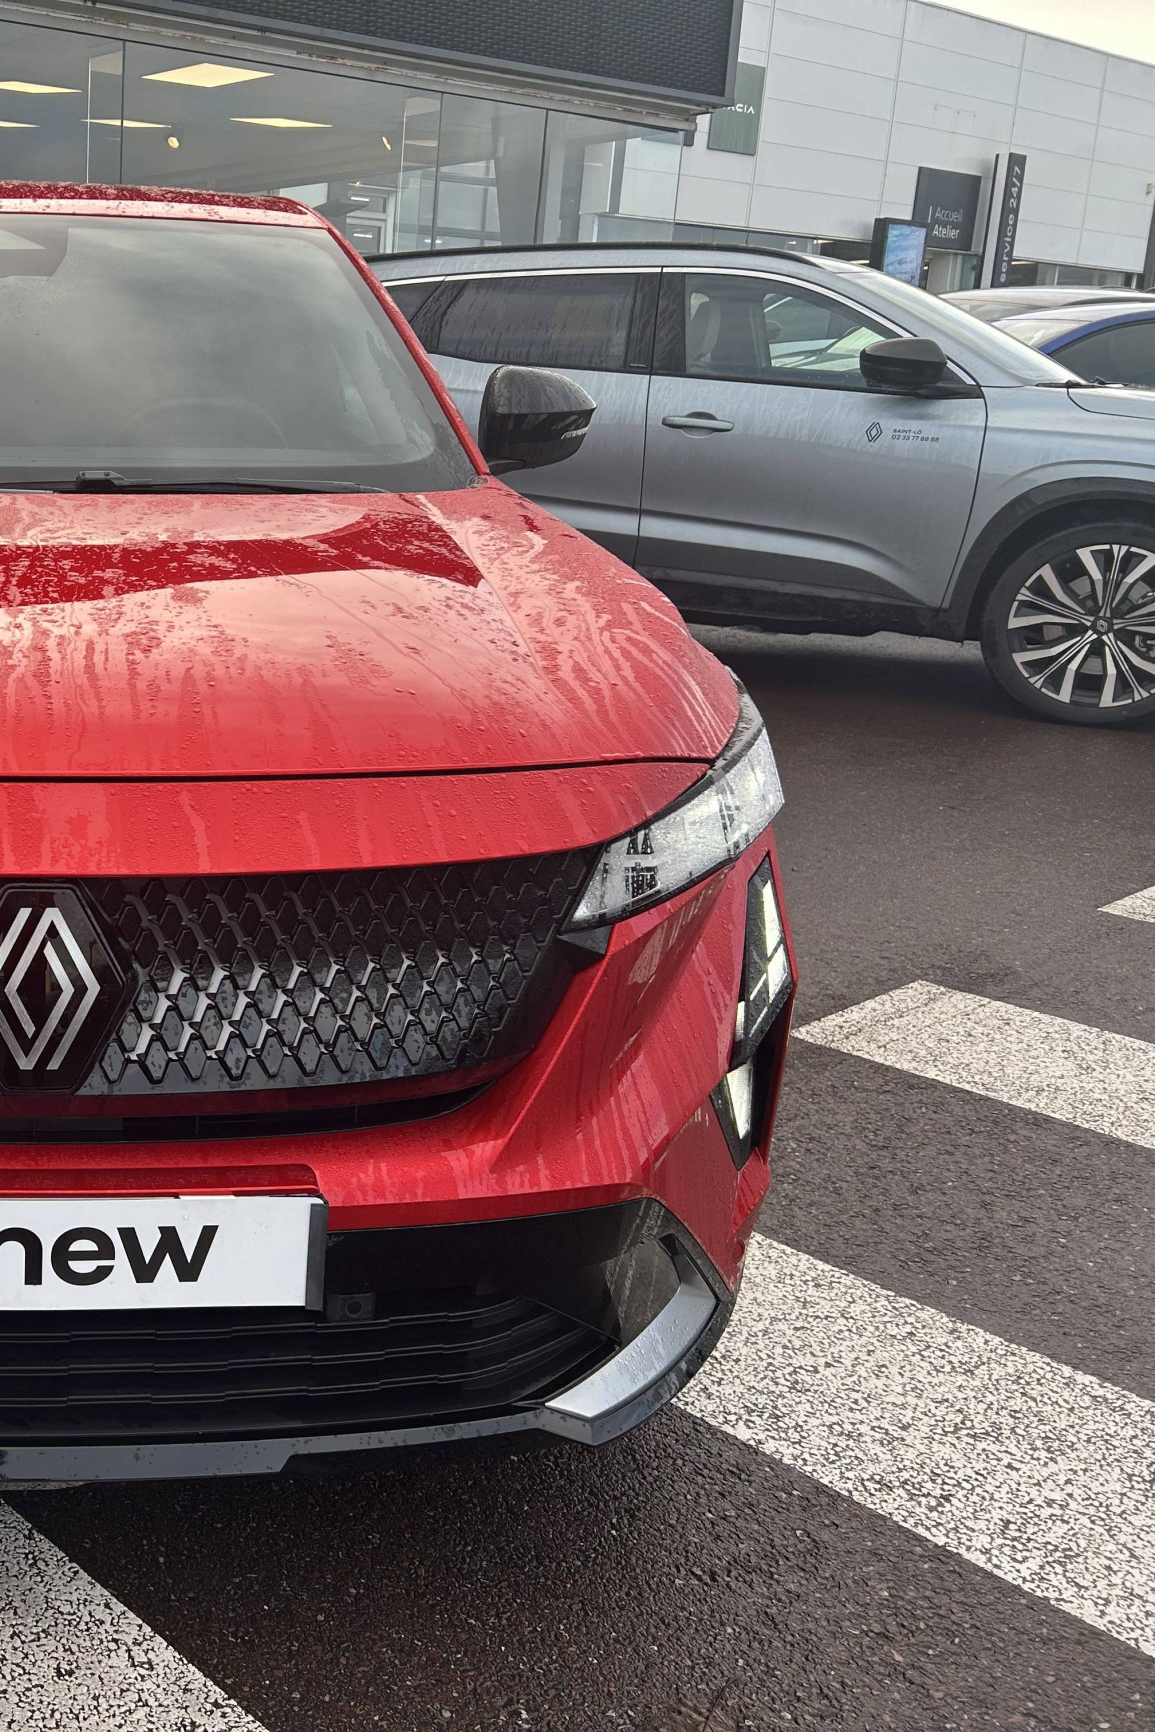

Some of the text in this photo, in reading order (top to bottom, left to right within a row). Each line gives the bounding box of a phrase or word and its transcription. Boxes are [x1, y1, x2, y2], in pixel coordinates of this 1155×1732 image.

[723, 103, 755, 115] ACIA
[934, 206, 964, 222] Accueil
[1000, 165, 1021, 282] service 24/7
[932, 224, 960, 239] Atelier
